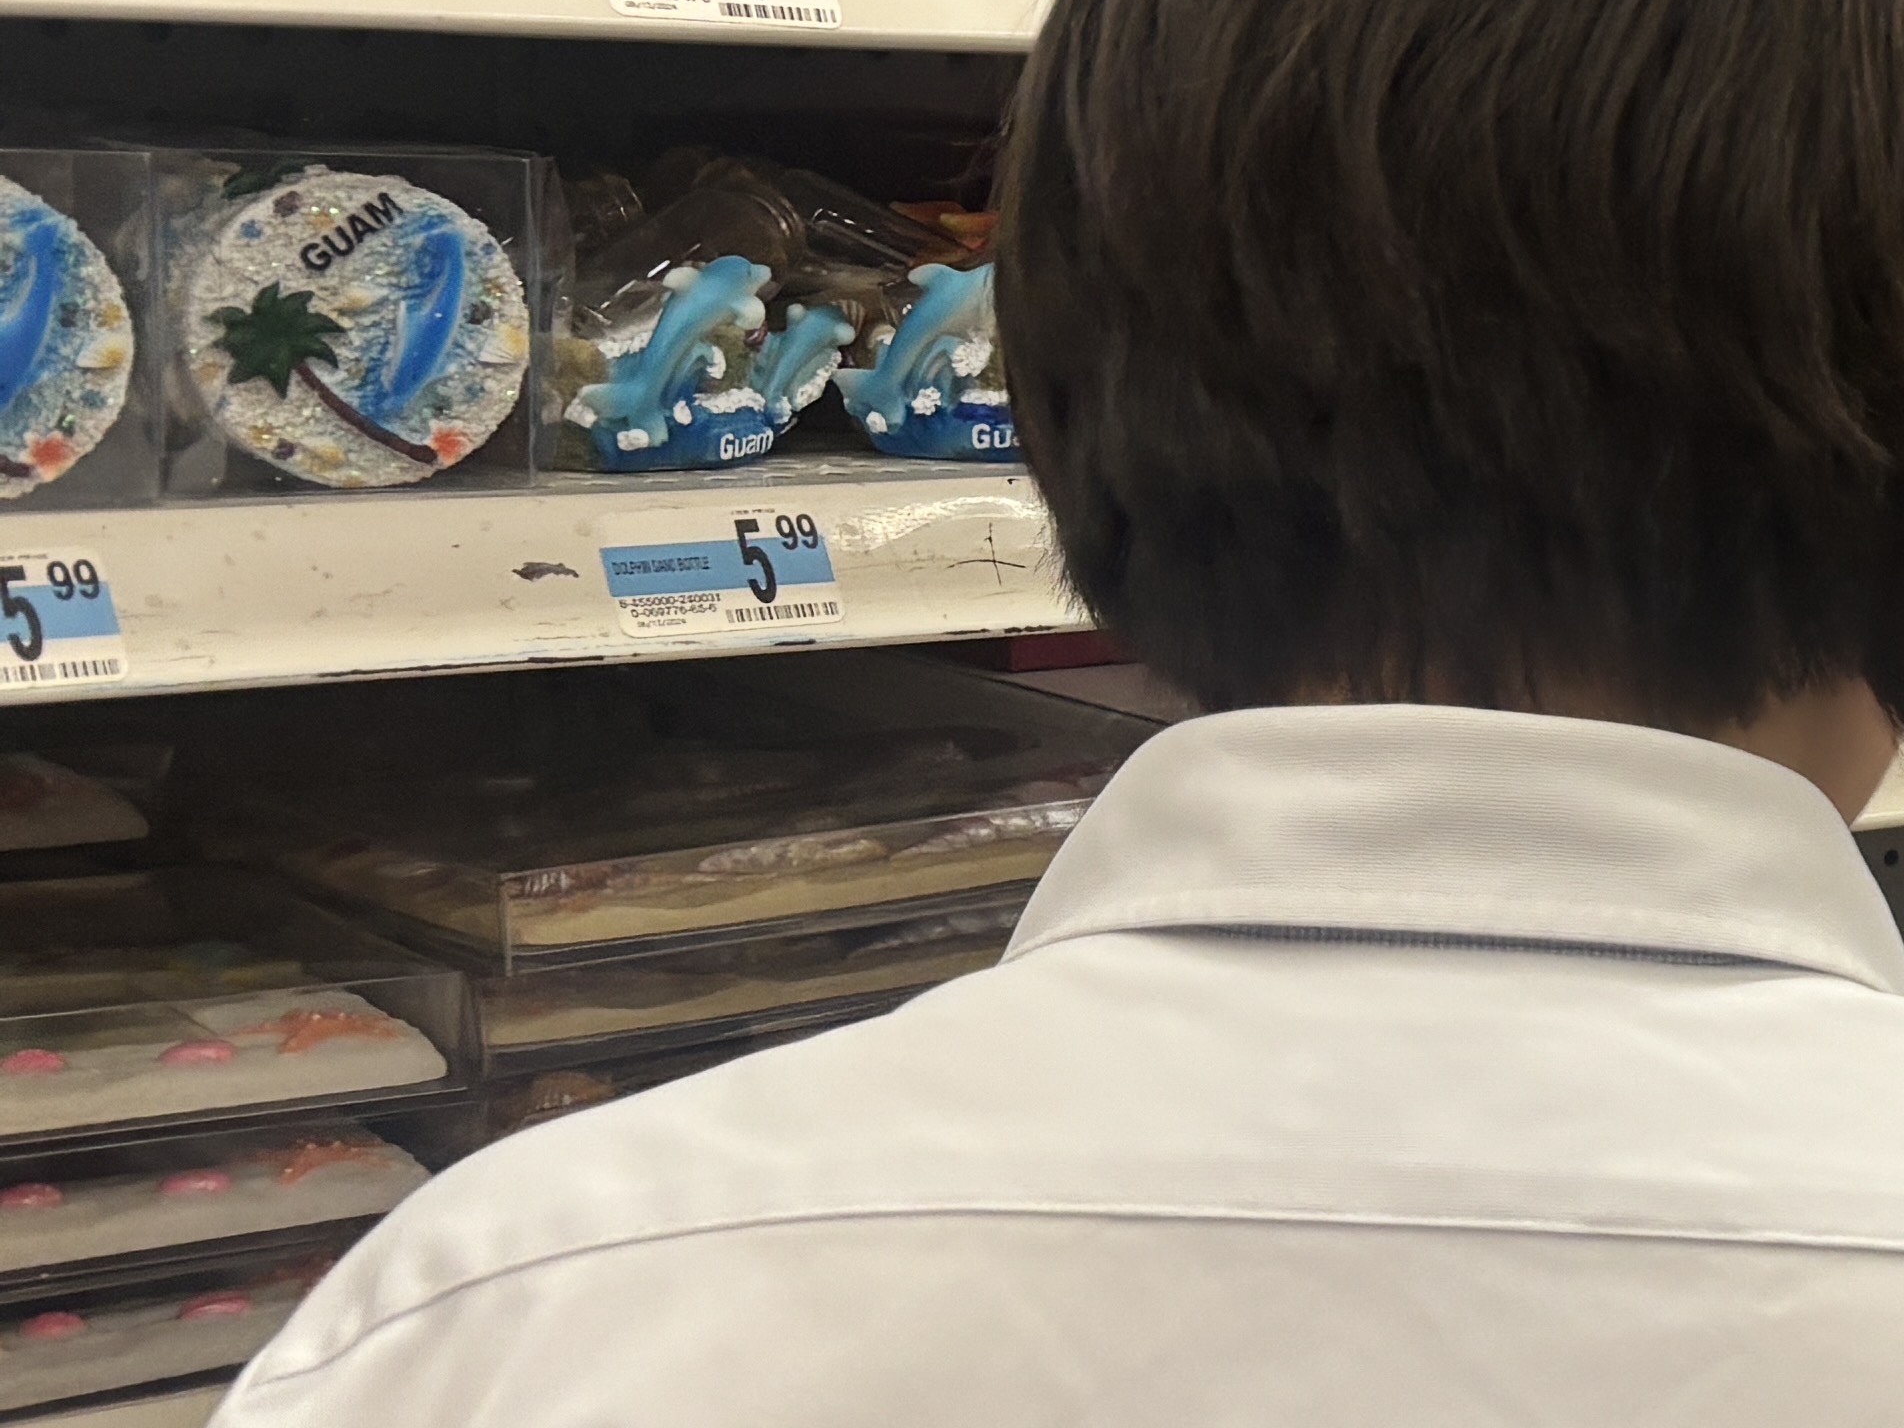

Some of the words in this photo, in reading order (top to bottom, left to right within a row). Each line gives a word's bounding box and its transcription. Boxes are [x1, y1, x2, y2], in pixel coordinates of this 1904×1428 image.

[301, 192, 404, 271] GUAM
[719, 428, 774, 460] Guam
[734, 518, 778, 604] 5
[775, 513, 819, 550] 99
[0, 564, 43, 662] 5
[46, 558, 101, 602] 99
